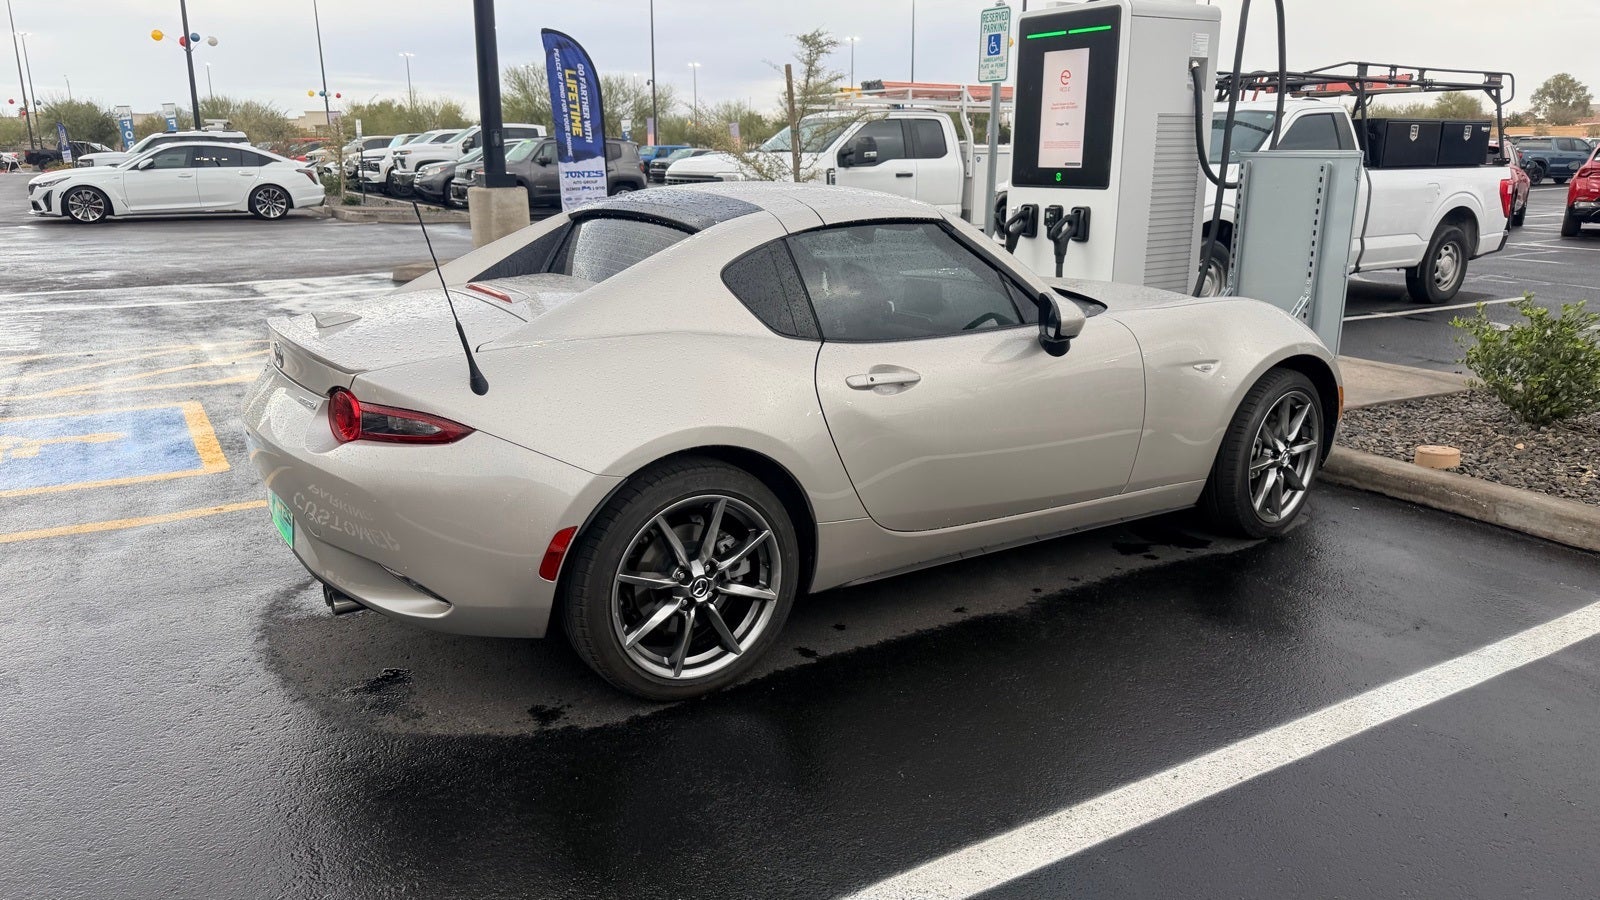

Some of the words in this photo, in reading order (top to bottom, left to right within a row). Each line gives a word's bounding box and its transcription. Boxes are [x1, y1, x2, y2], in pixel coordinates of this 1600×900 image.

[982, 10, 1008, 23] RESERVED
[983, 21, 1007, 34] PARKING
[553, 48, 562, 71] PEACE
[577, 63, 585, 77] GO
[565, 68, 583, 138] LIFETIME
[580, 77, 590, 119] FARTHER
[583, 120, 593, 144] WITH
[565, 170, 604, 178] JONES
